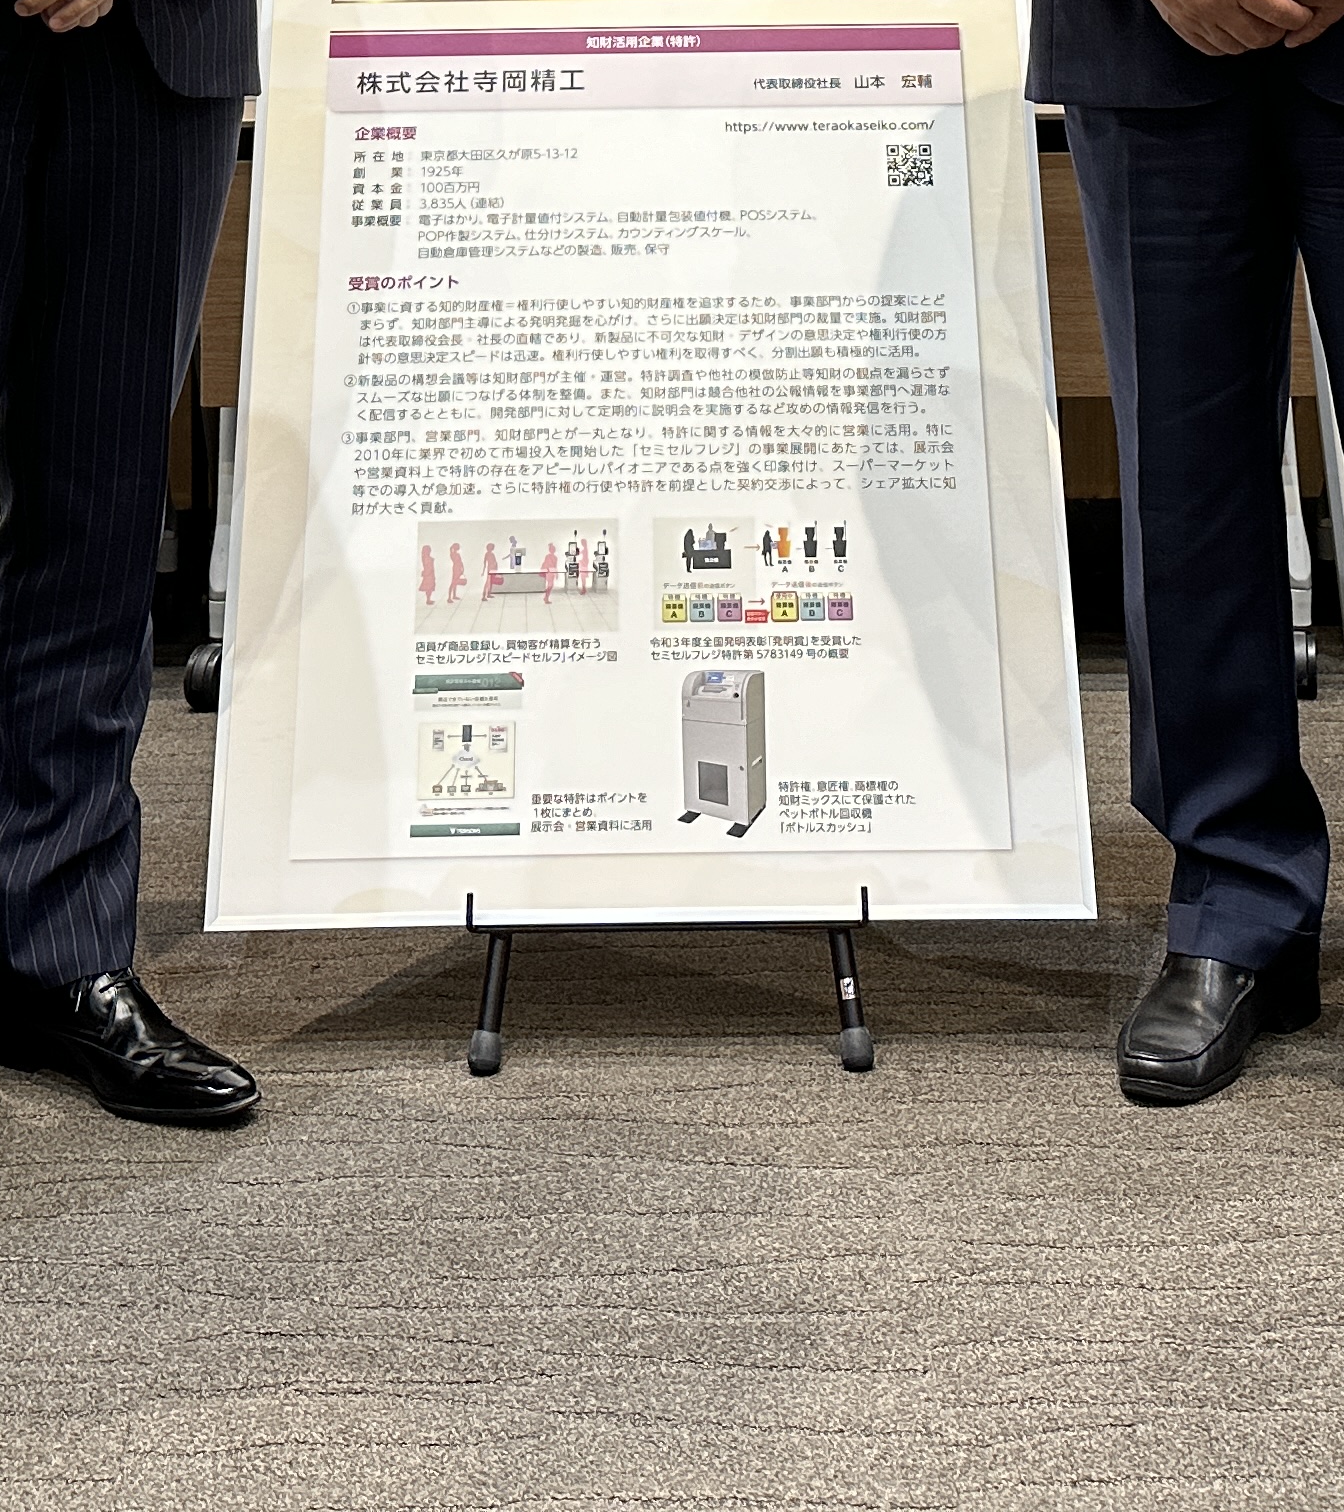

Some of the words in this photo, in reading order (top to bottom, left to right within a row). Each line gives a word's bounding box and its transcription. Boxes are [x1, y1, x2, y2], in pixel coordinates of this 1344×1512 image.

[357, 69, 585, 93] 株式会社寺岡精工
[754, 76, 841, 90] 代表取締役社長
[855, 74, 885, 89] 山本
[902, 74, 933, 89] 宏輔
[355, 127, 417, 140] 企業概要
[421, 148, 578, 162] 東京都大田区久が原5-13-12
[421, 166, 463, 178] 1925年
[421, 182, 480, 194] 100百万円
[349, 275, 459, 291] 受賞のポイント
[352, 501, 453, 516] 財が大きく貢献。
[757, 649, 803, 659] 5783149
[531, 793, 647, 804] 重要な特許はポイントを
[779, 794, 916, 806] 知財ミックスにて保護された
[779, 808, 872, 819] ペットボトル回収機
[531, 820, 651, 833] 展示会・営業資料に活用
